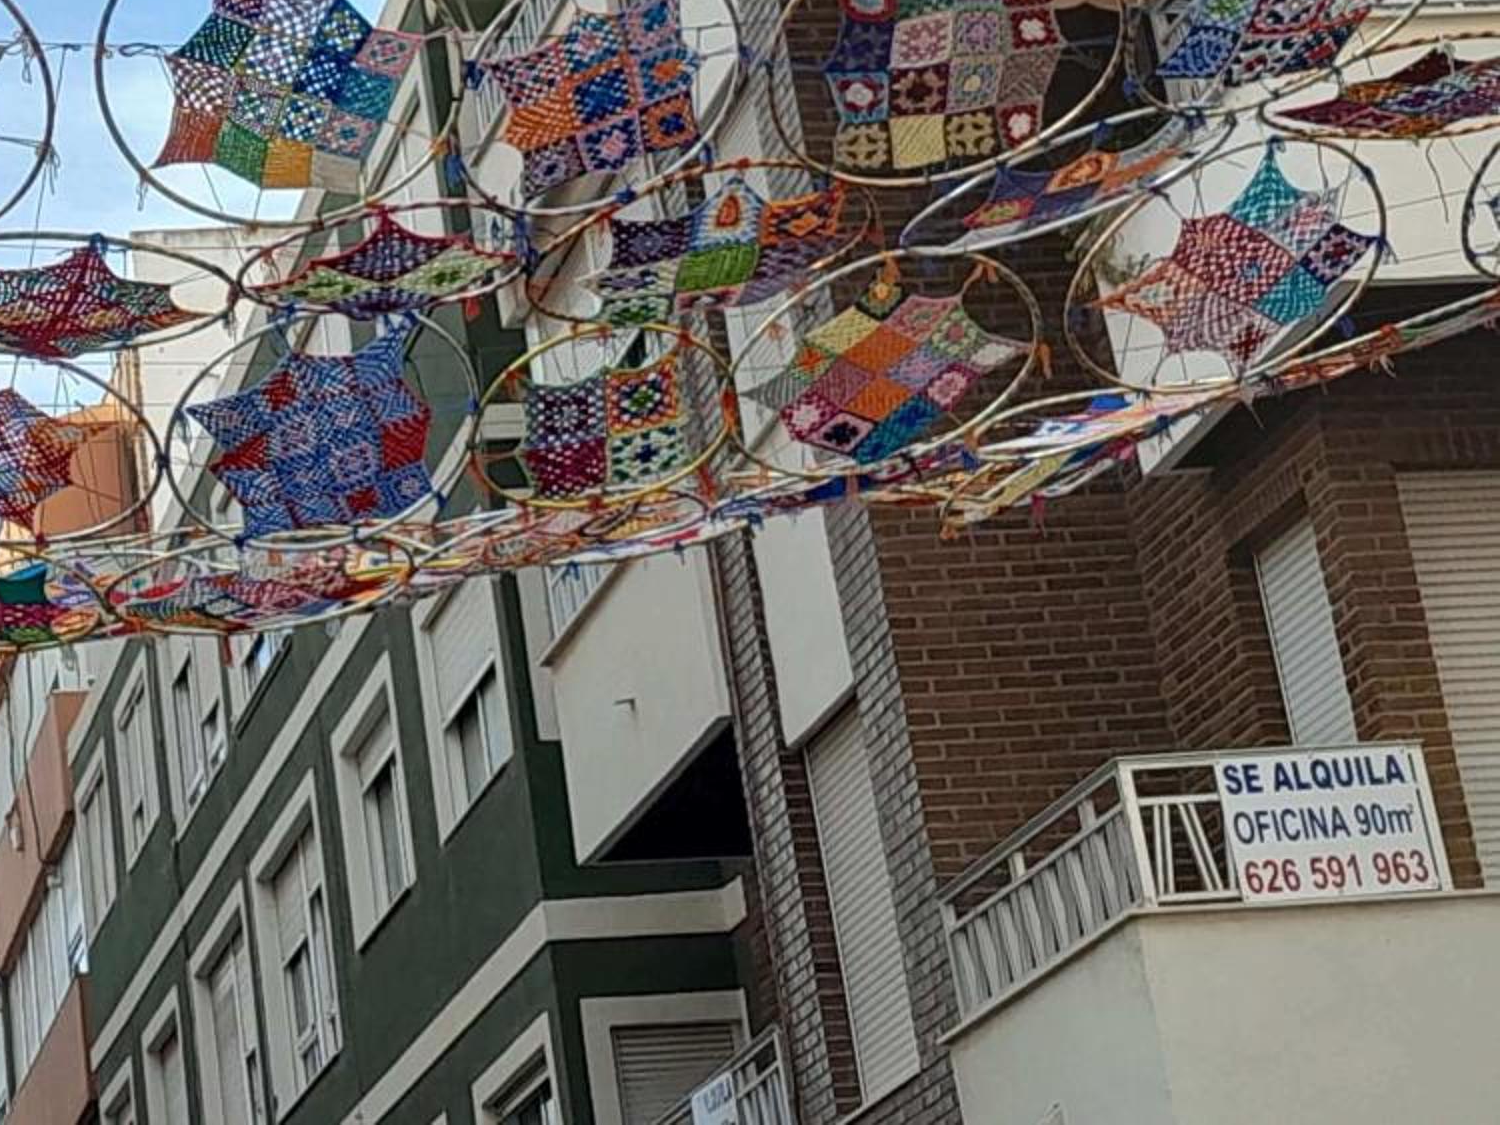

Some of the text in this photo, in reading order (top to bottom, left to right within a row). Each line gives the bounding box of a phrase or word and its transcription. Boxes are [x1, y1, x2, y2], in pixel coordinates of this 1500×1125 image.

[1224, 755, 1406, 795] SE ALQUILA
[1234, 805, 1350, 845] OFICINA
[1245, 849, 1429, 894] 626 591 963
